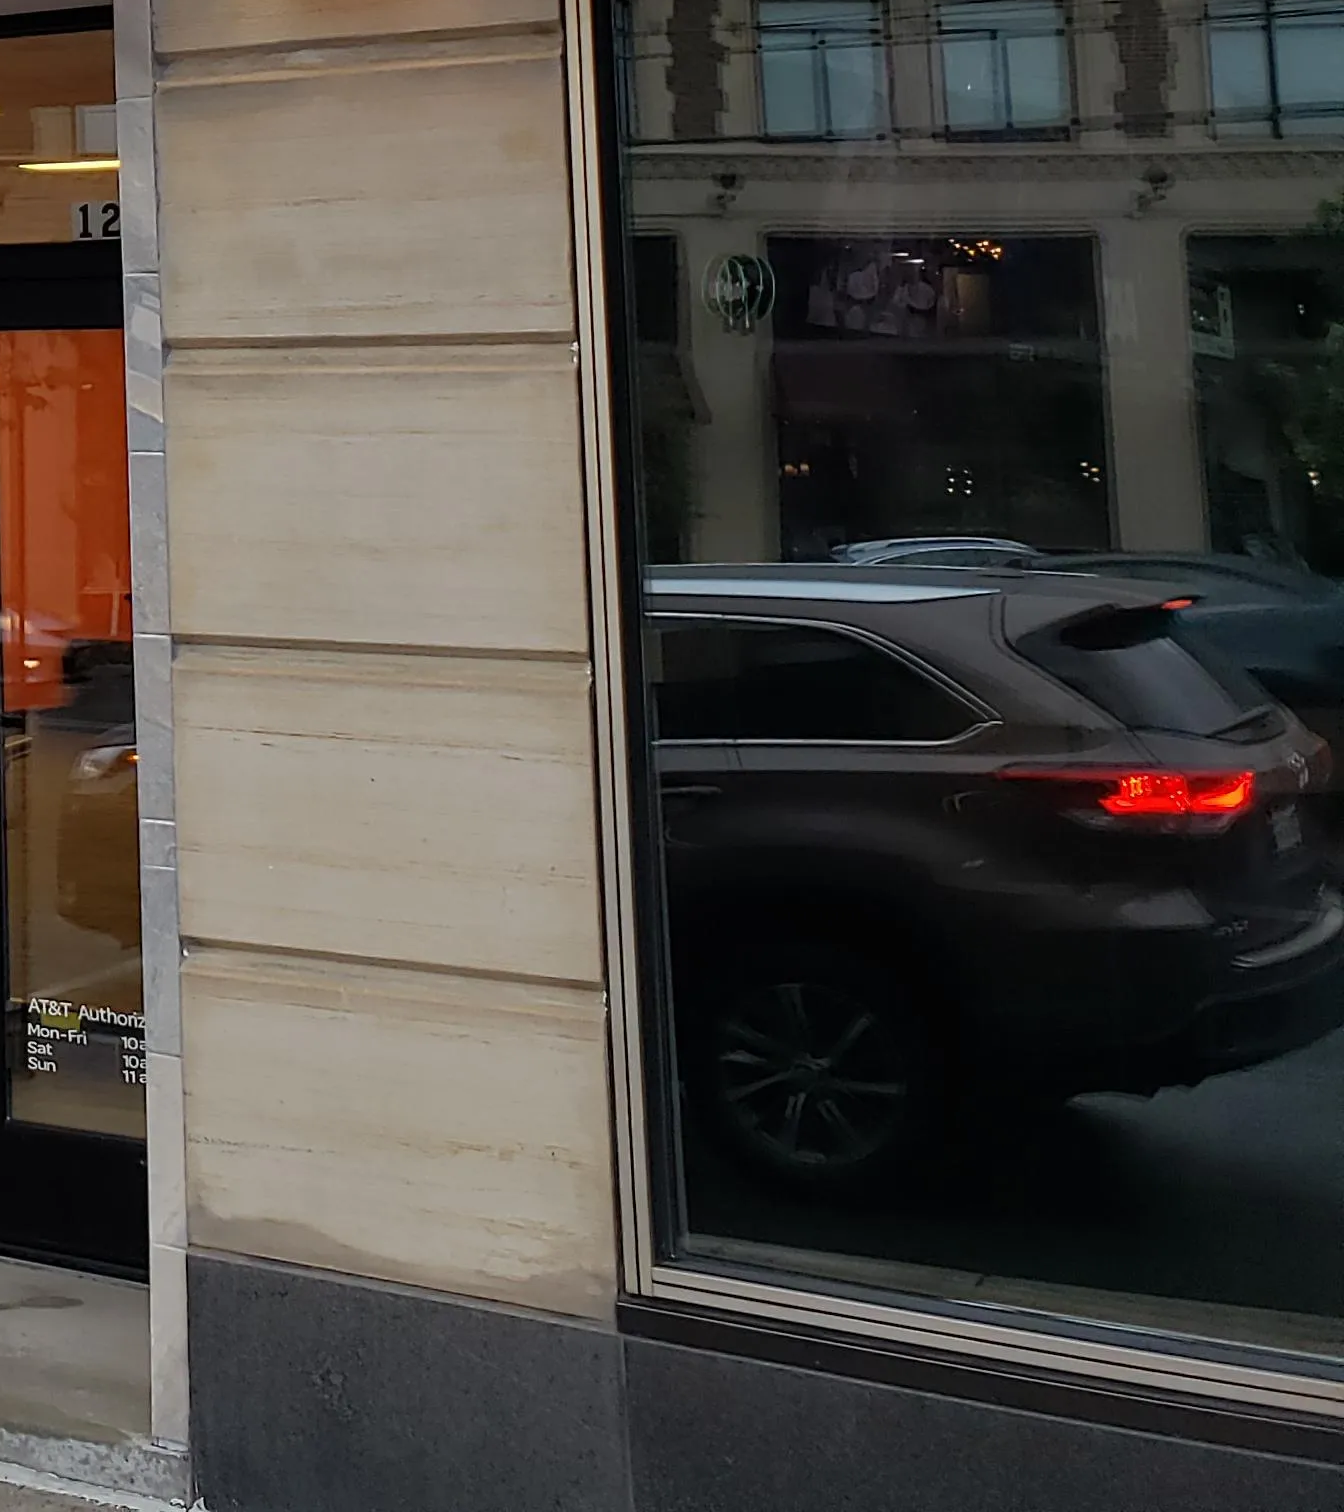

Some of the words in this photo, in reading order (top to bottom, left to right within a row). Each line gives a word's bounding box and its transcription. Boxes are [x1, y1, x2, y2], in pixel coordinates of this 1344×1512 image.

[28, 997, 72, 1018] AT&T
[27, 1022, 88, 1046] Mon-Fri
[27, 1040, 53, 1056] Sat
[27, 1056, 57, 1073] Sun
